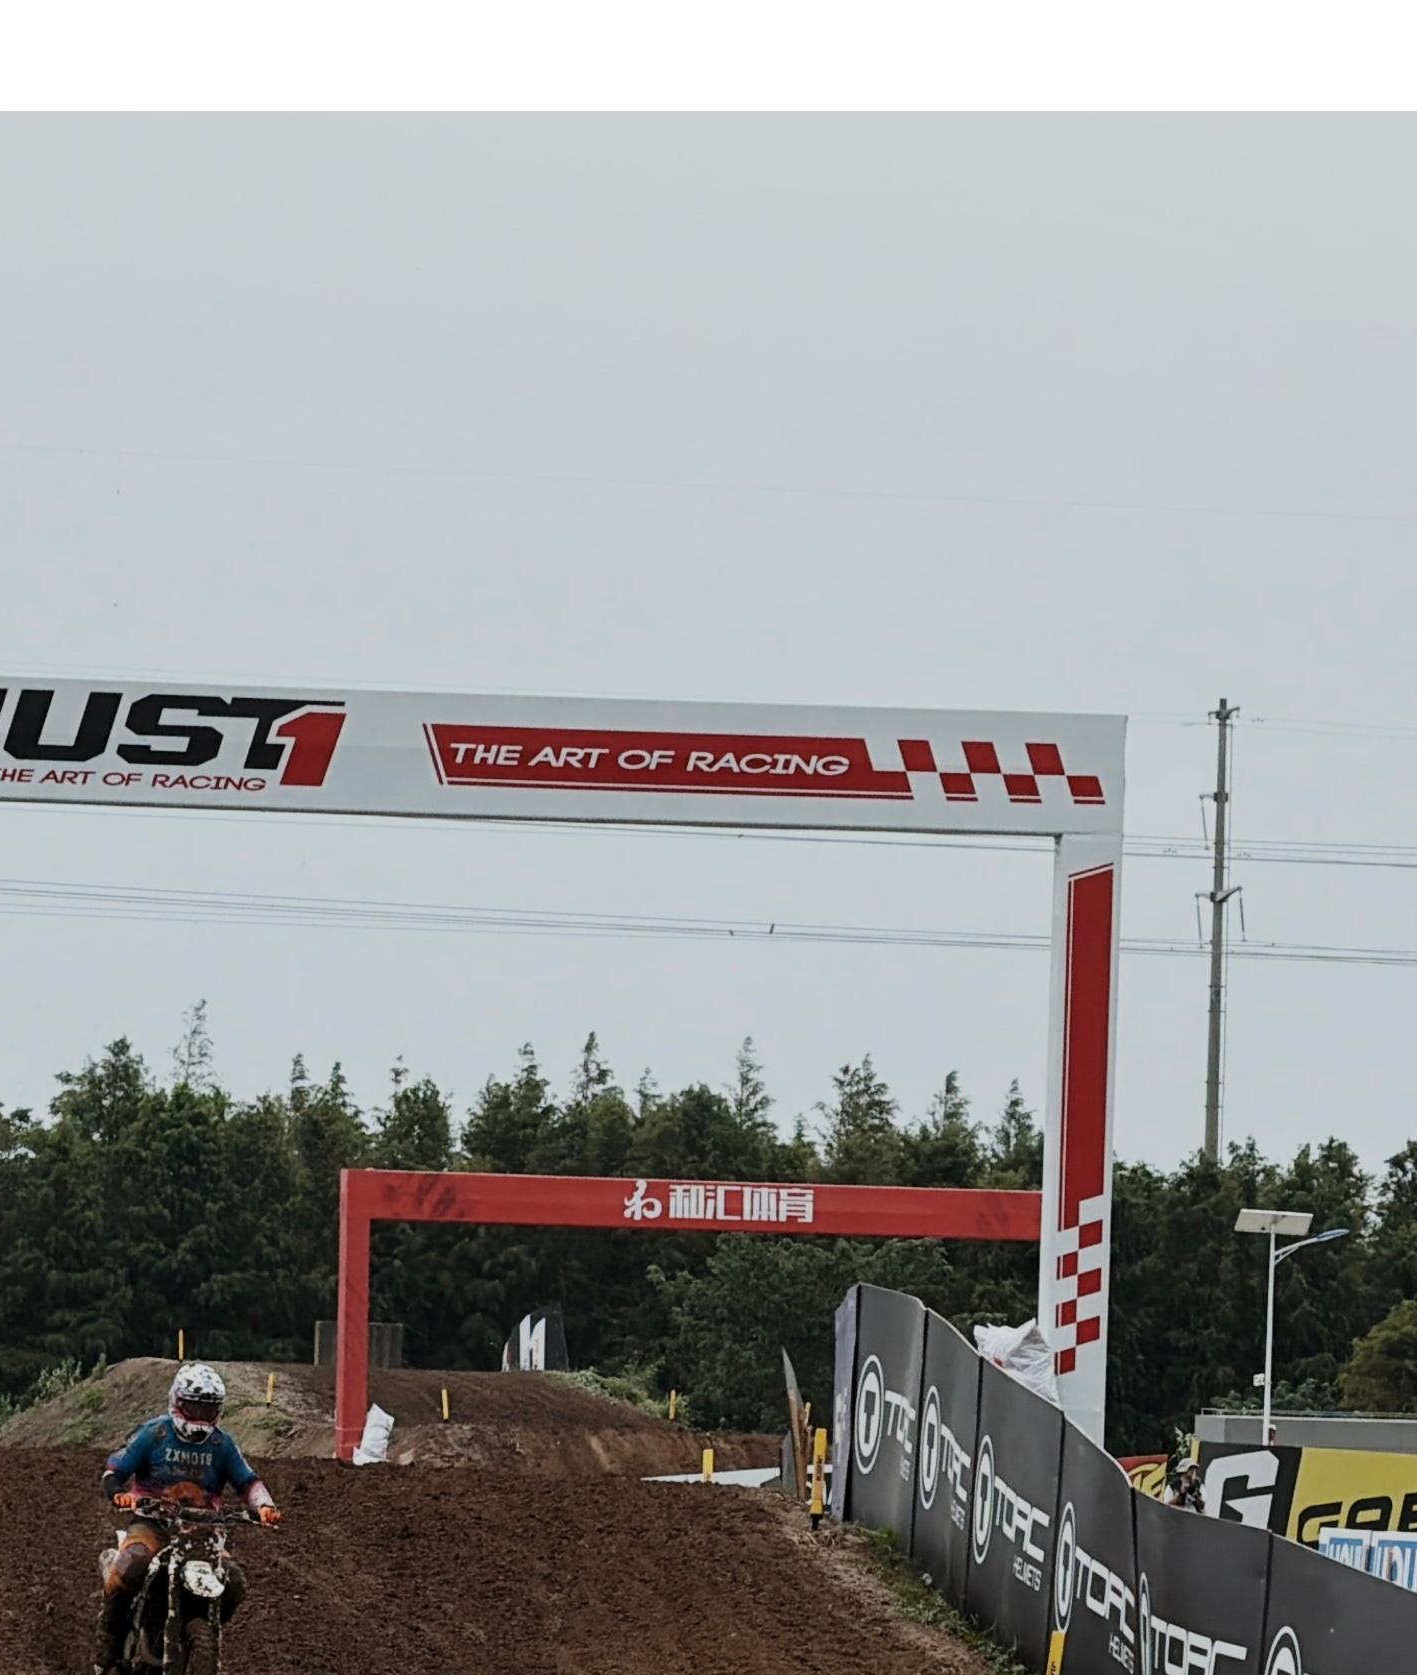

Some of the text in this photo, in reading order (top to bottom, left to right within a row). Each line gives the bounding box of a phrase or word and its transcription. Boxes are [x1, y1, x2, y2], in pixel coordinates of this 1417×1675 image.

[449, 742, 850, 777] THE ART OF RACING
[38, 768, 97, 786] ART
[102, 771, 144, 787] OF
[151, 773, 267, 792] RACING
[669, 1184, 815, 1224] 和汇体育
[994, 1475, 1051, 1563] TORC
